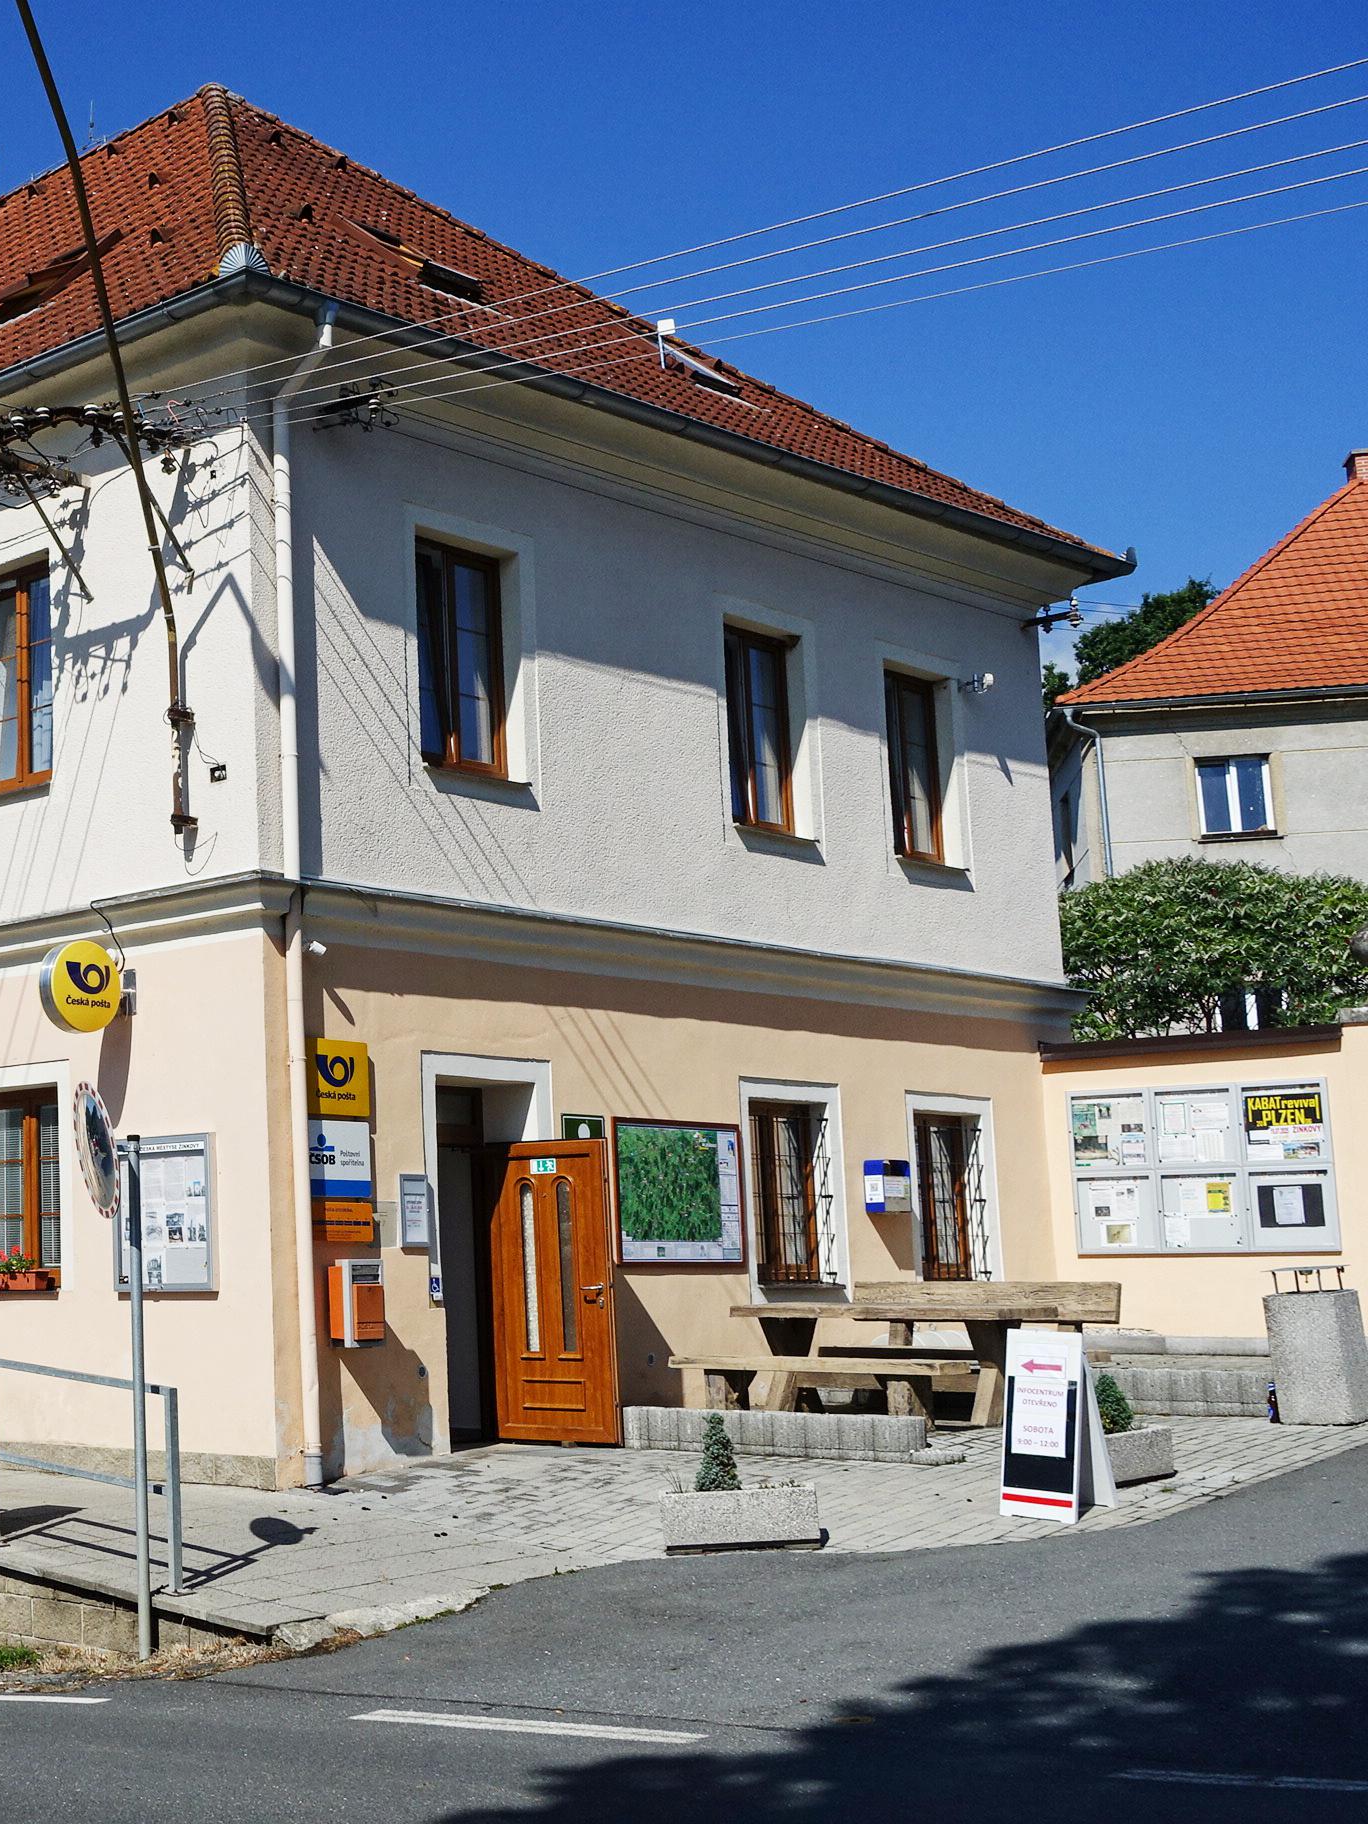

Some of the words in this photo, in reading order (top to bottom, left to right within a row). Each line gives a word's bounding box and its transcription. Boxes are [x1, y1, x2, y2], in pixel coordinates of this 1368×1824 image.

[66, 995, 89, 1006] Česká
[91, 998, 111, 1008] pošta
[316, 1088, 336, 1099] Česká
[337, 1092, 356, 1101] pošta
[309, 1152, 336, 1165] ČSOB
[1016, 1387, 1064, 1397] INFOCENTRUM
[1023, 1425, 1054, 1434] SOBOTA
